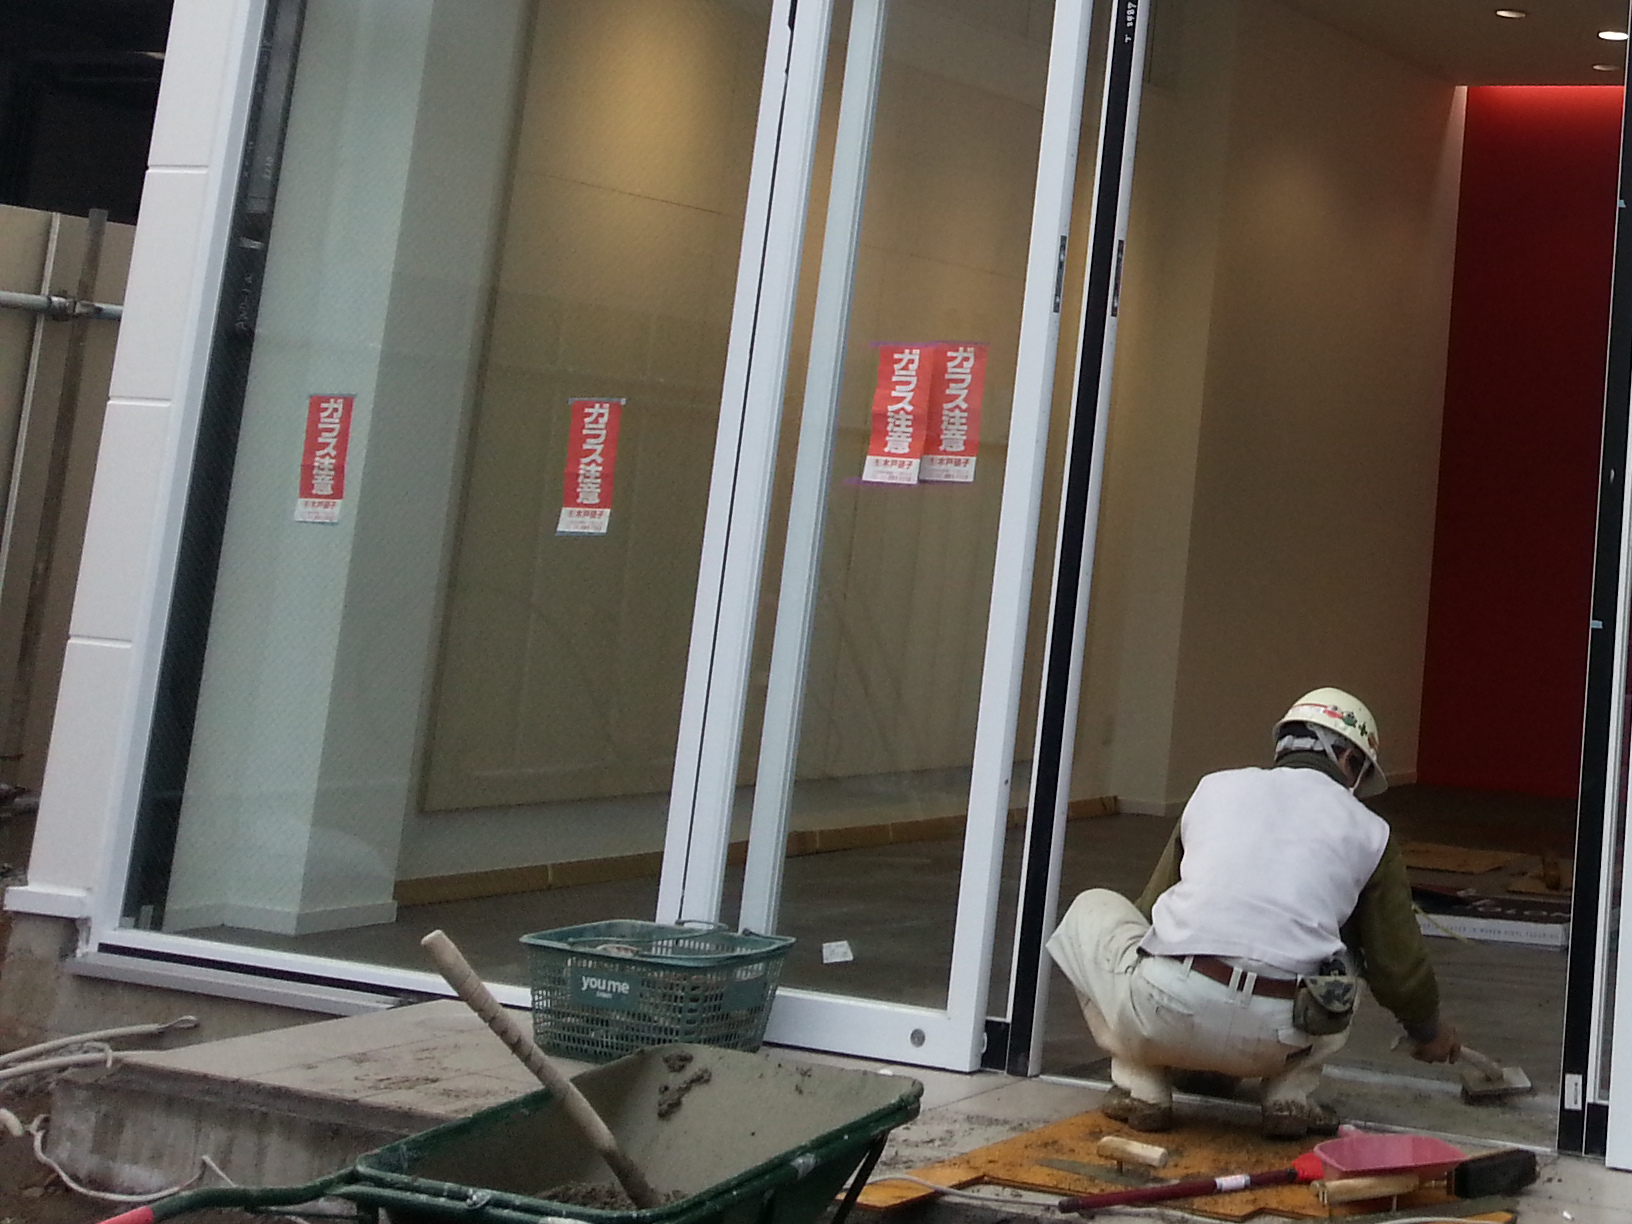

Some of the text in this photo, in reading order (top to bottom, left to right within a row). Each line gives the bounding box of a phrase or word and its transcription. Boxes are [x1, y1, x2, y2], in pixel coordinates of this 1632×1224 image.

[312, 398, 344, 495] ガラス注意
[884, 349, 920, 454] ガラス注意
[939, 347, 975, 452] ガラス注意
[576, 403, 610, 504] ガラス注意
